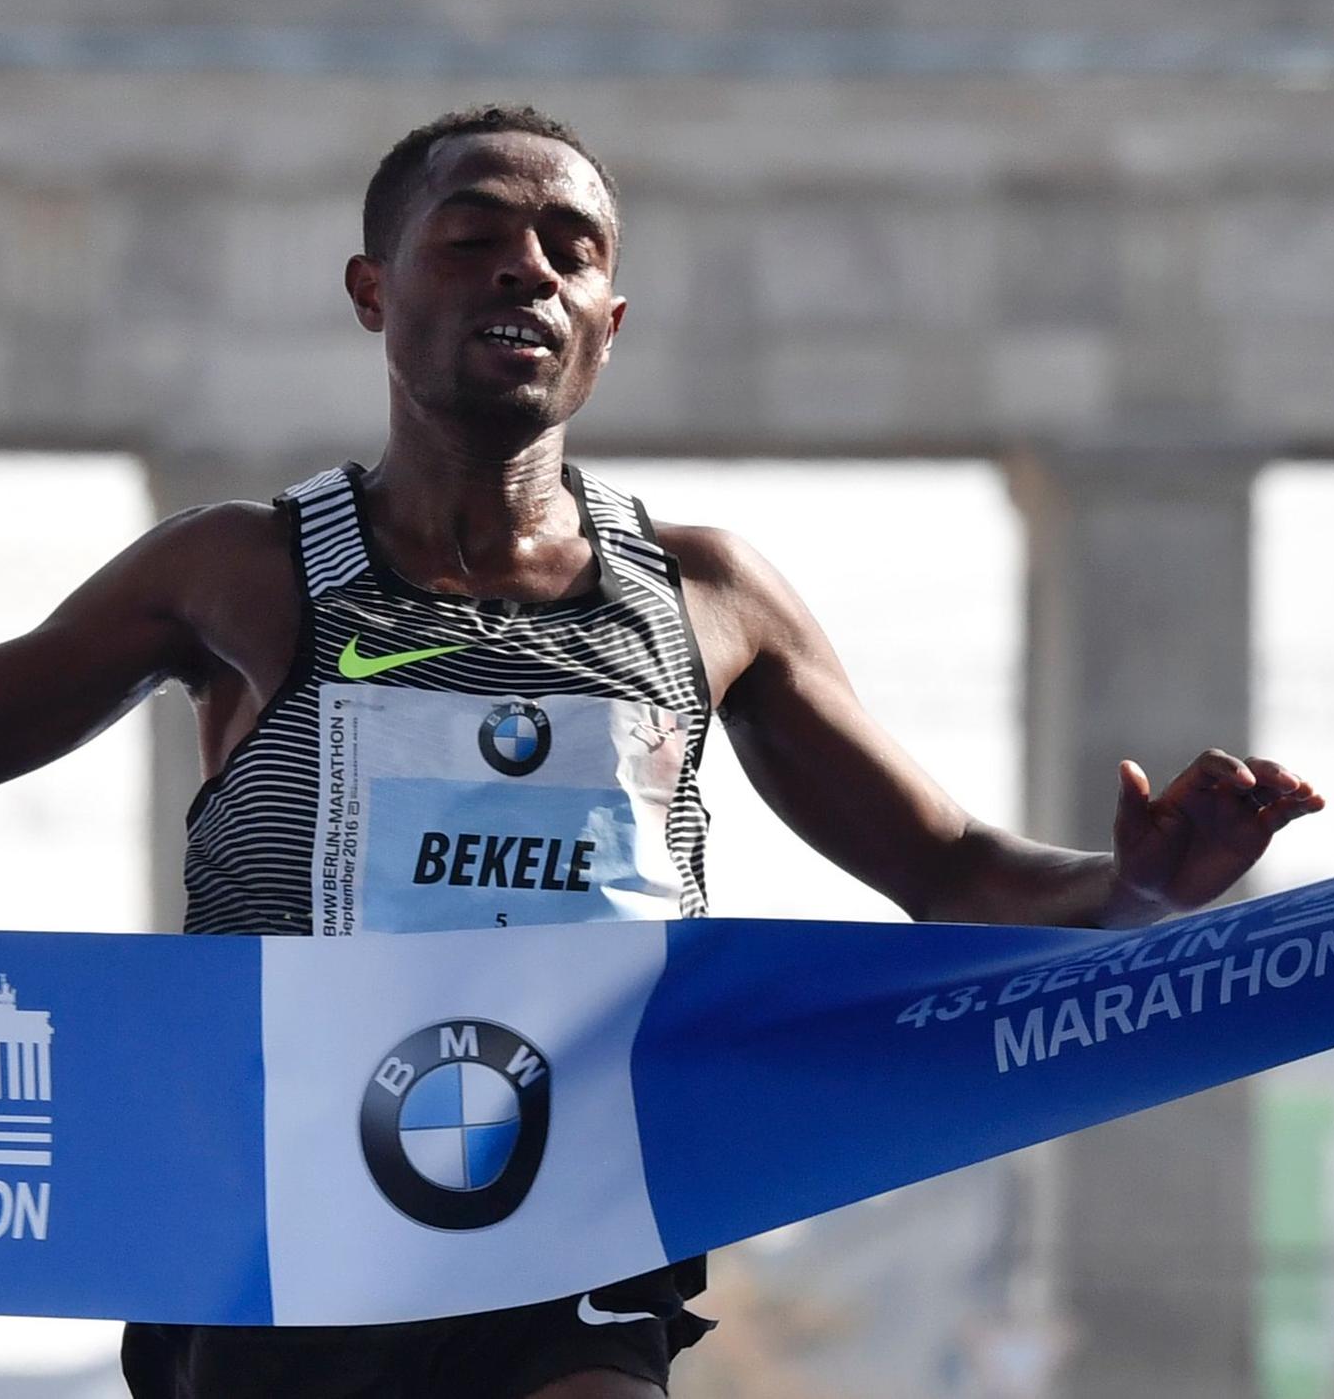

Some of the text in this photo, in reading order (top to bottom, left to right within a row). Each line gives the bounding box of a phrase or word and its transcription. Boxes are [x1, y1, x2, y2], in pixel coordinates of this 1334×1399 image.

[487, 703, 547, 728] BMW
[323, 717, 344, 936] BMW BERLIN-MARATHON
[343, 821, 359, 858] 2016
[413, 832, 596, 892] BEKELE
[896, 920, 1240, 1028] 43. BERLIN
[375, 1025, 547, 1098] BMW
